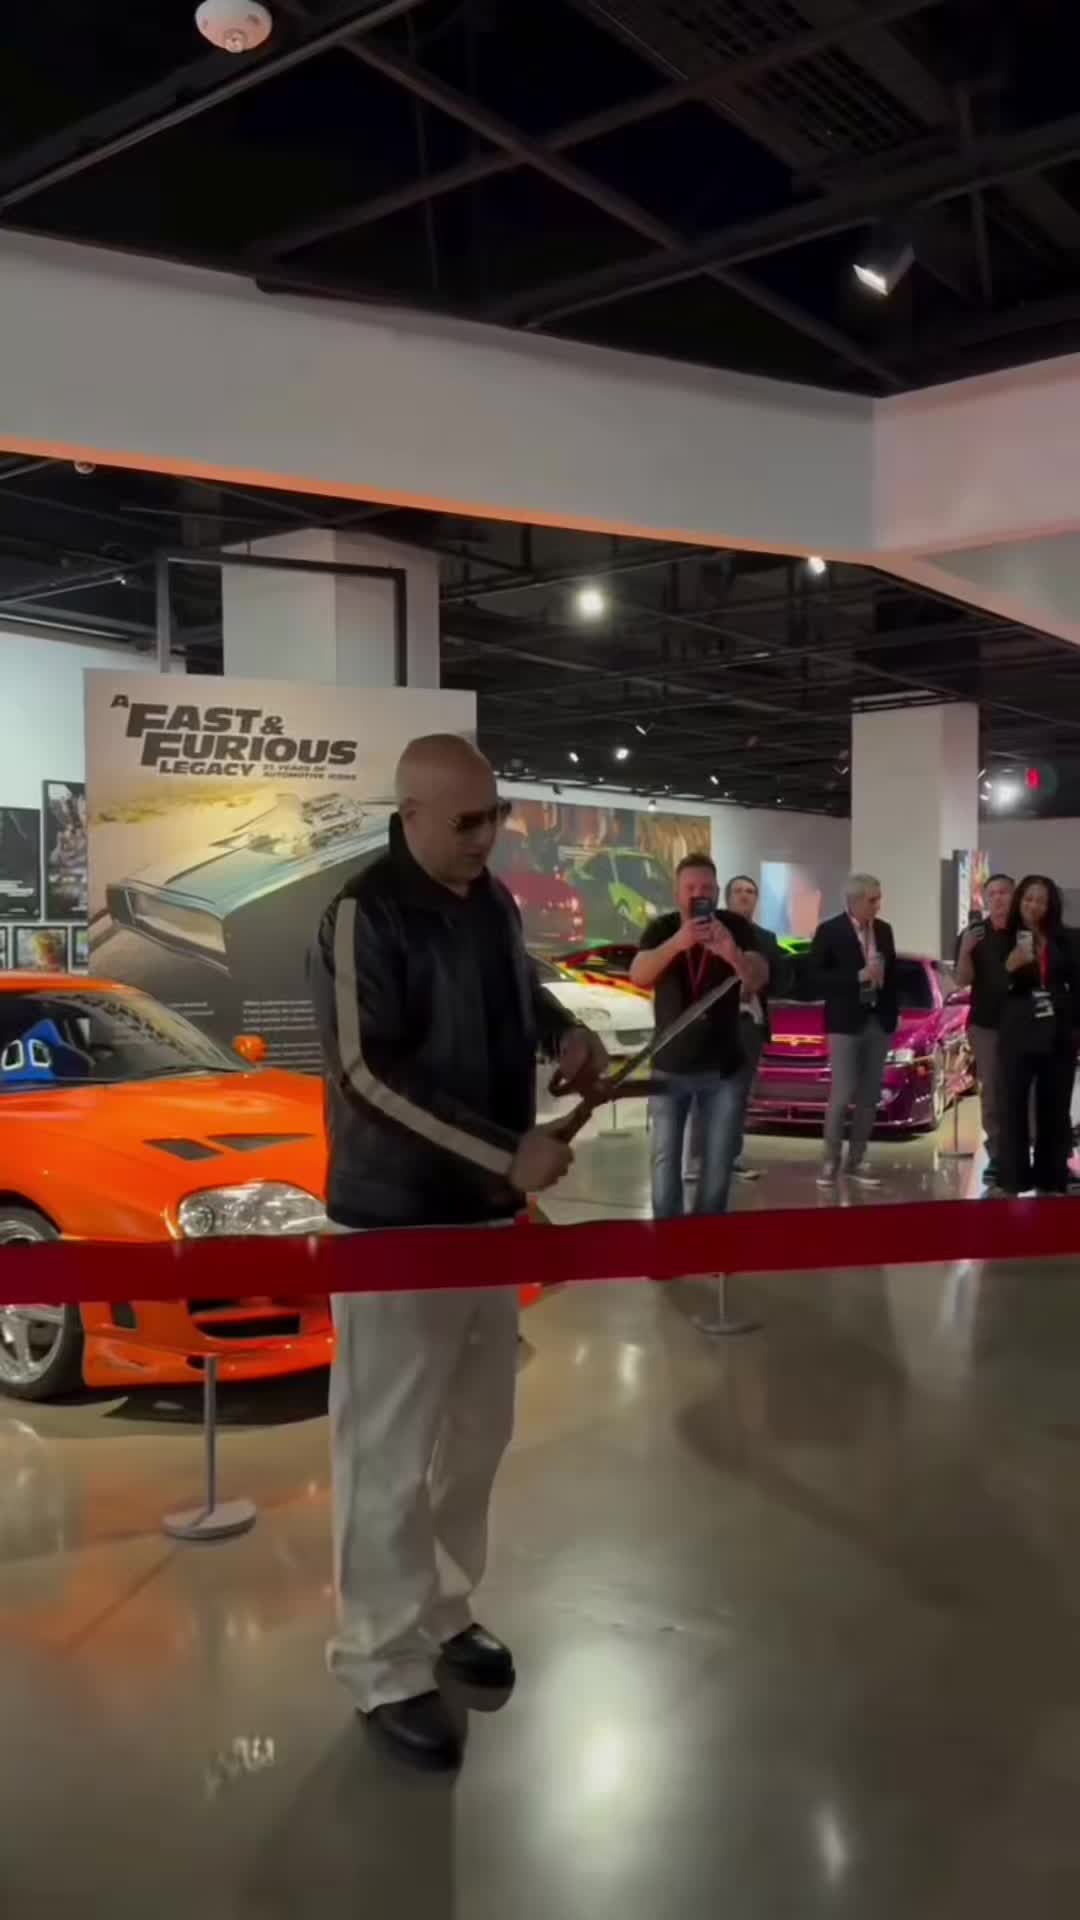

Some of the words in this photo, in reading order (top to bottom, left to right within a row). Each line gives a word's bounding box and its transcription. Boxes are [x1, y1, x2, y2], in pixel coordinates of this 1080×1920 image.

[110, 694, 129, 708] A
[125, 703, 262, 738] FAST
[261, 715, 285, 735] &
[140, 732, 358, 766] FURIOUS
[159, 761, 254, 776] LEGACY
